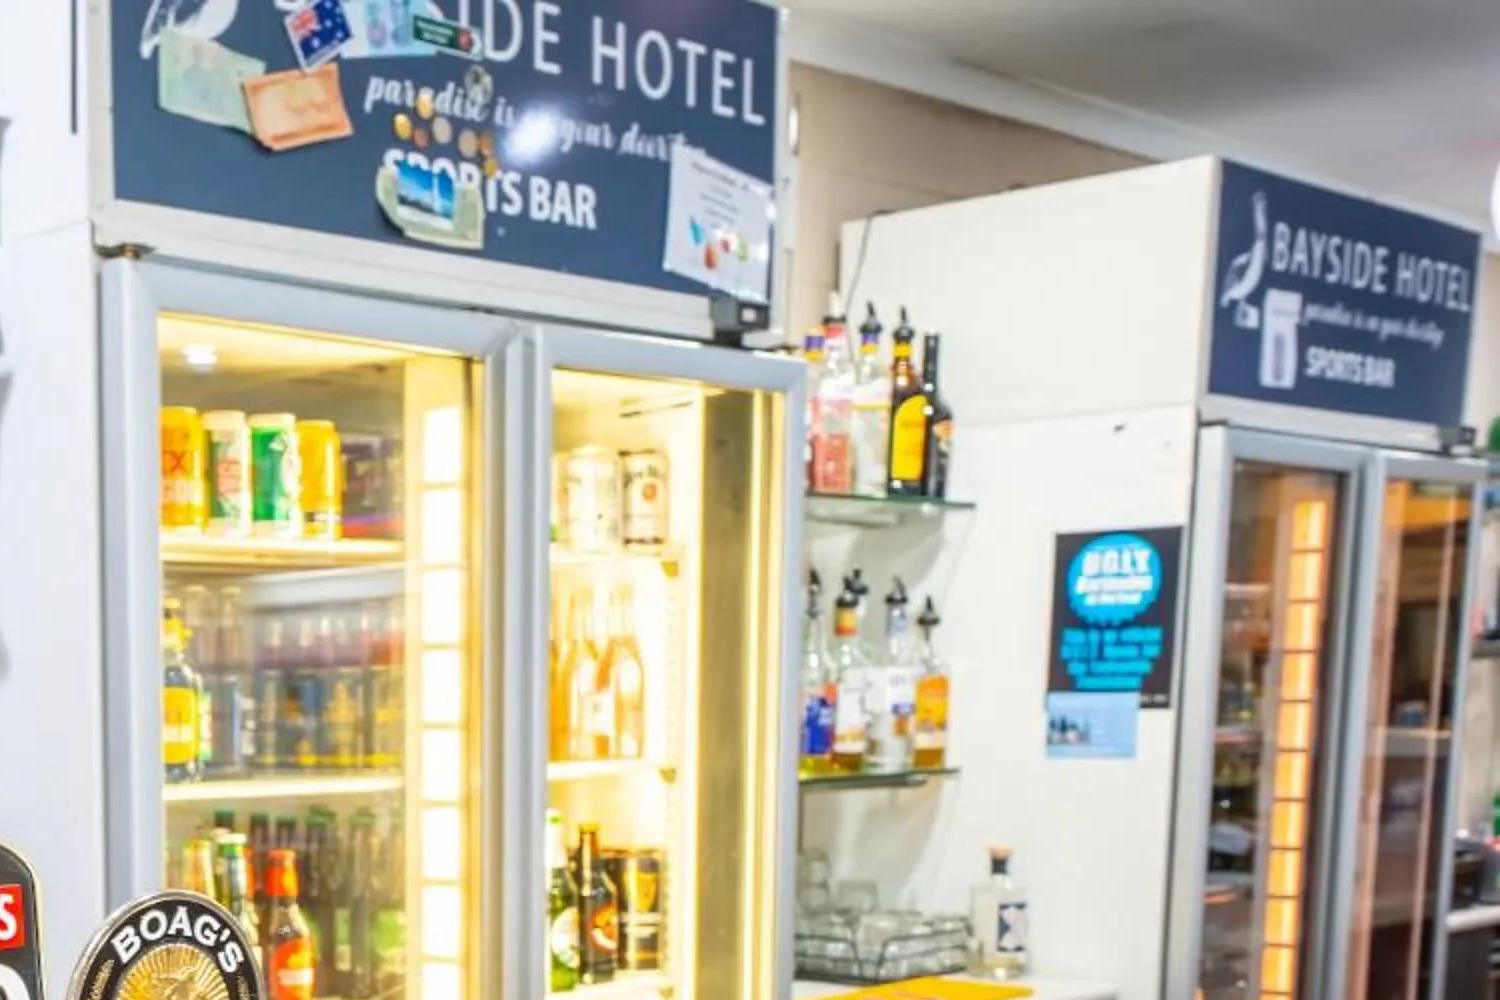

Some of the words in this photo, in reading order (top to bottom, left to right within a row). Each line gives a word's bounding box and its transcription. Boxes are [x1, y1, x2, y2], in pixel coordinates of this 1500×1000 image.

[364, 75, 490, 123] pardise
[592, 14, 767, 127] HOTEL
[528, 174, 597, 230] BAR
[1271, 221, 1390, 294] BAYSIDE
[1395, 252, 1473, 314] HOTEL
[1304, 345, 1363, 384] SPORTS
[110, 904, 245, 974] BOAG'S
